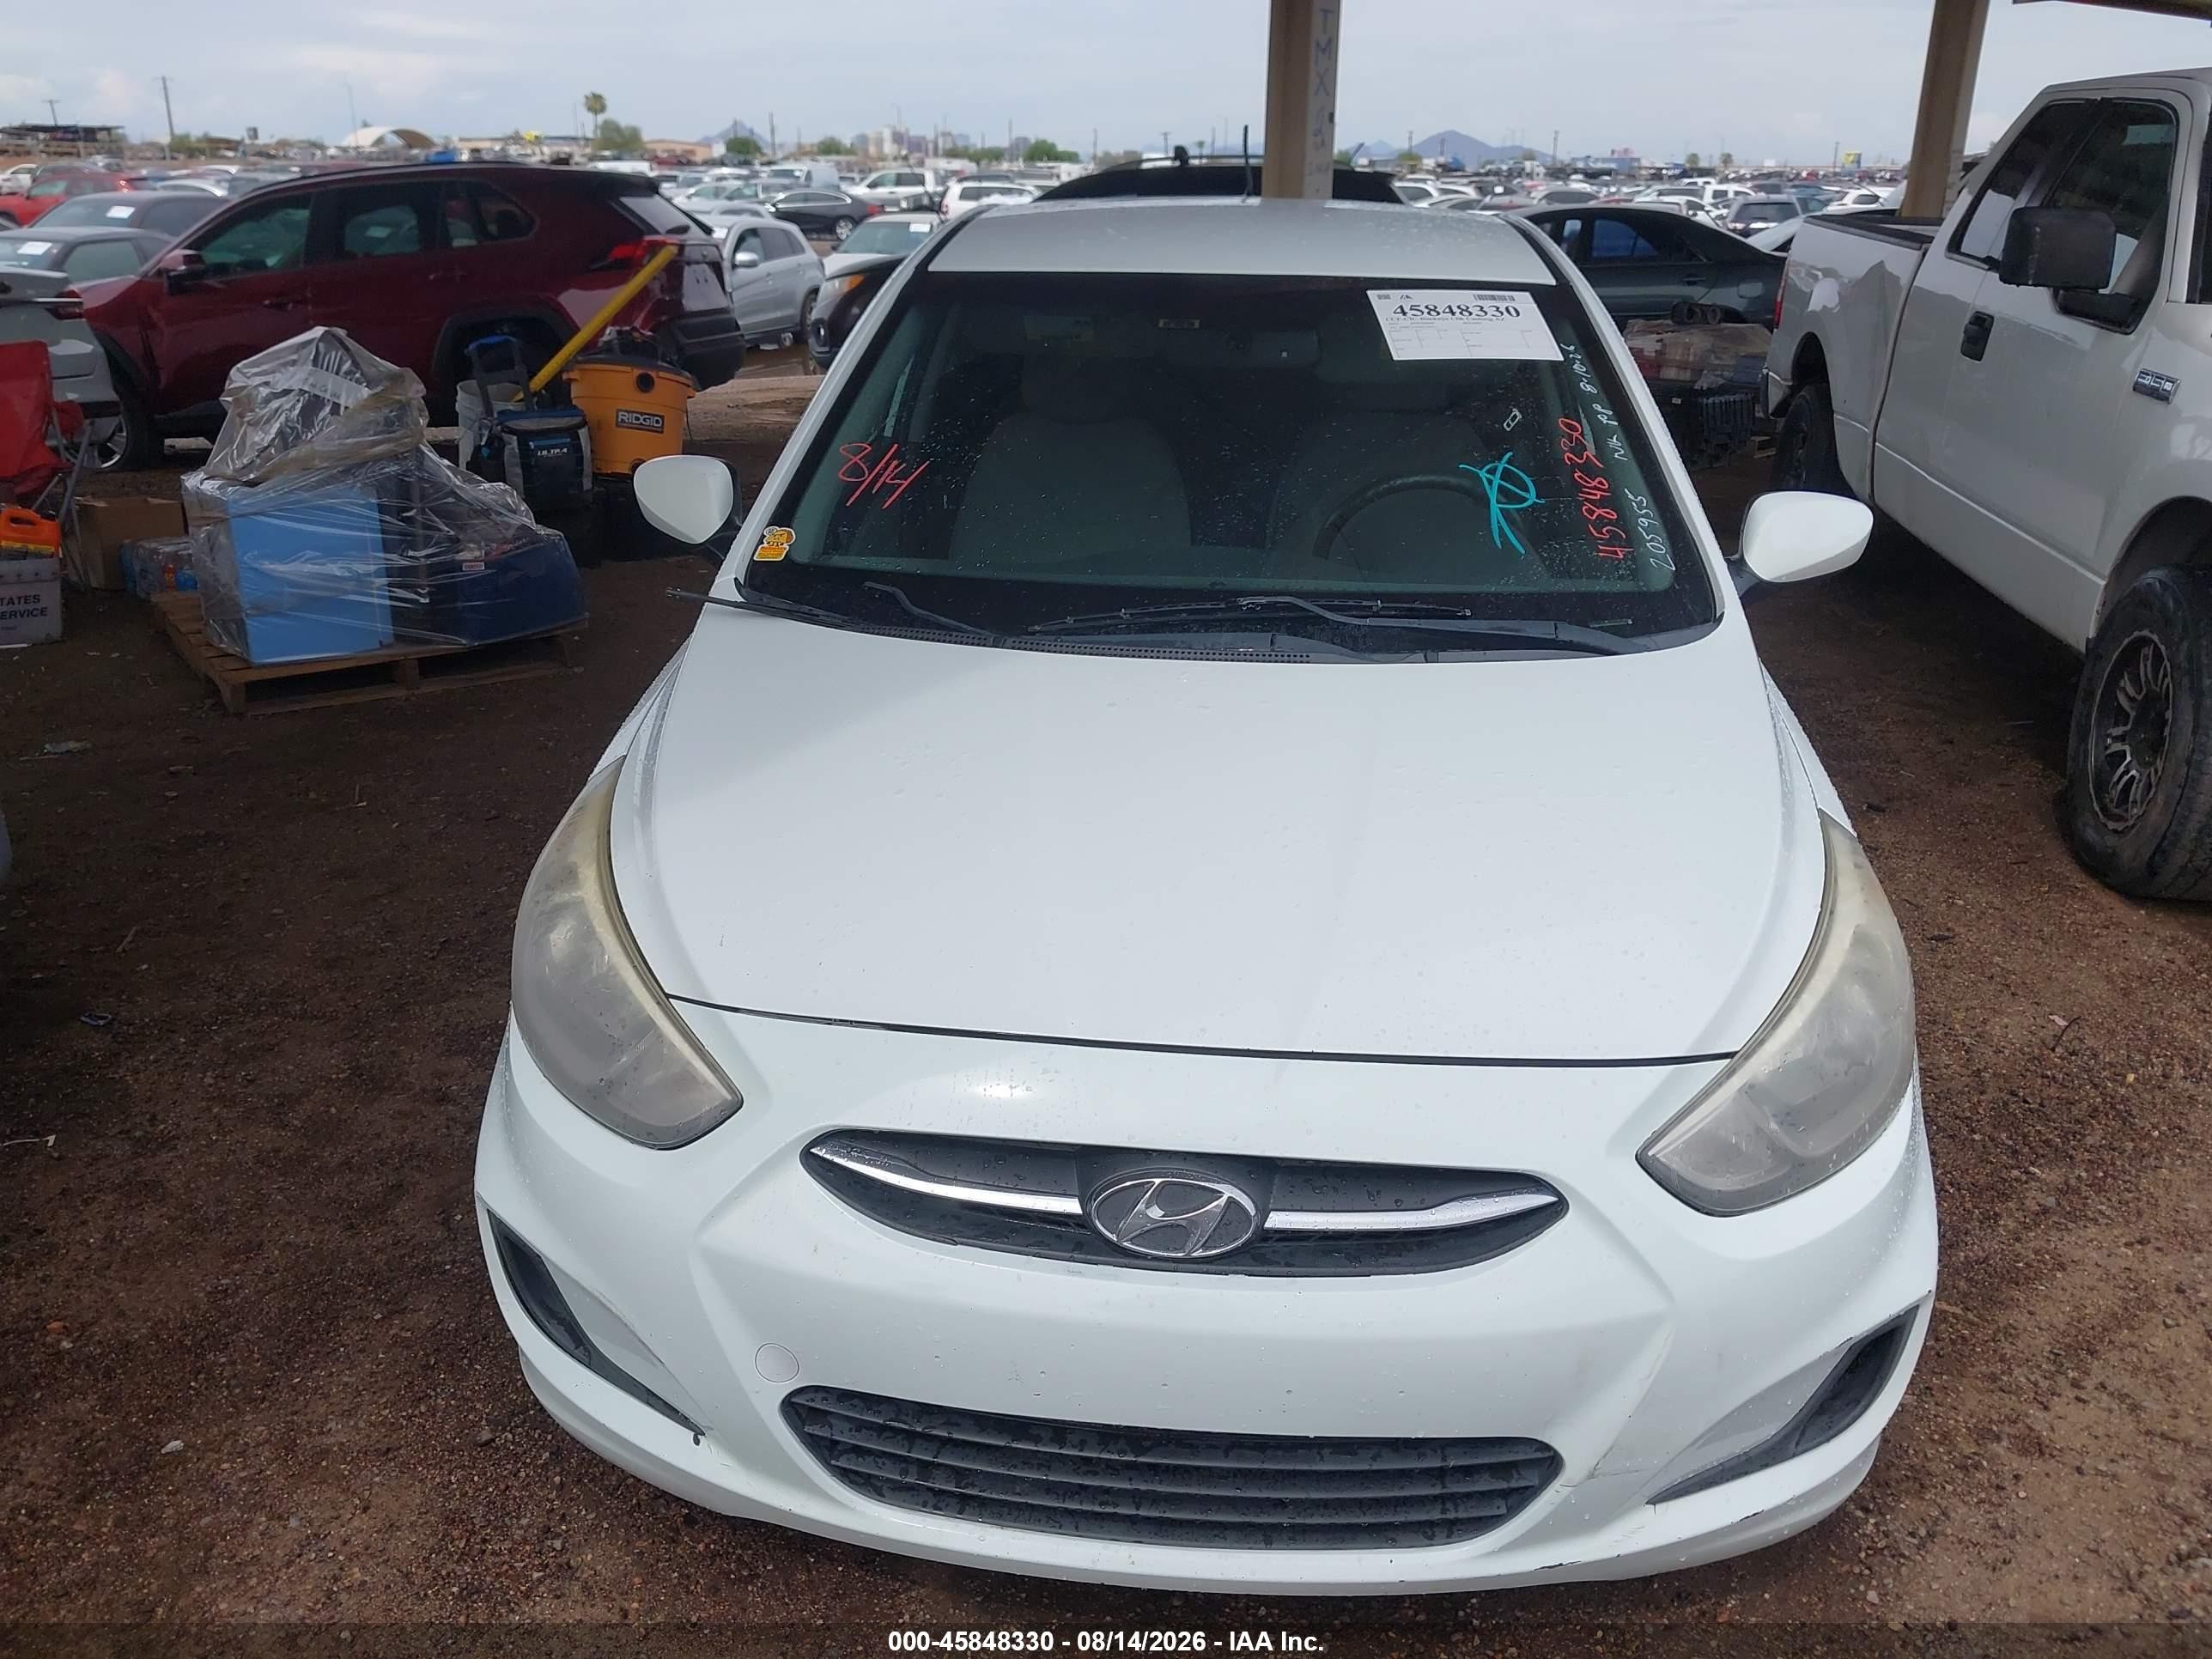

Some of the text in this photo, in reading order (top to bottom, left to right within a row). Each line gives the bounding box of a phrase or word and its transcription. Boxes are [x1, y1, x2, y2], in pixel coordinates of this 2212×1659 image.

[1393, 303, 1520, 319] 45848330
[617, 410, 663, 428] RIDGID
[838, 442, 930, 509] 8/14
[1559, 417, 1634, 560] 45848330
[0, 594, 41, 607] TATES
[0, 607, 48, 620] ERVICE
